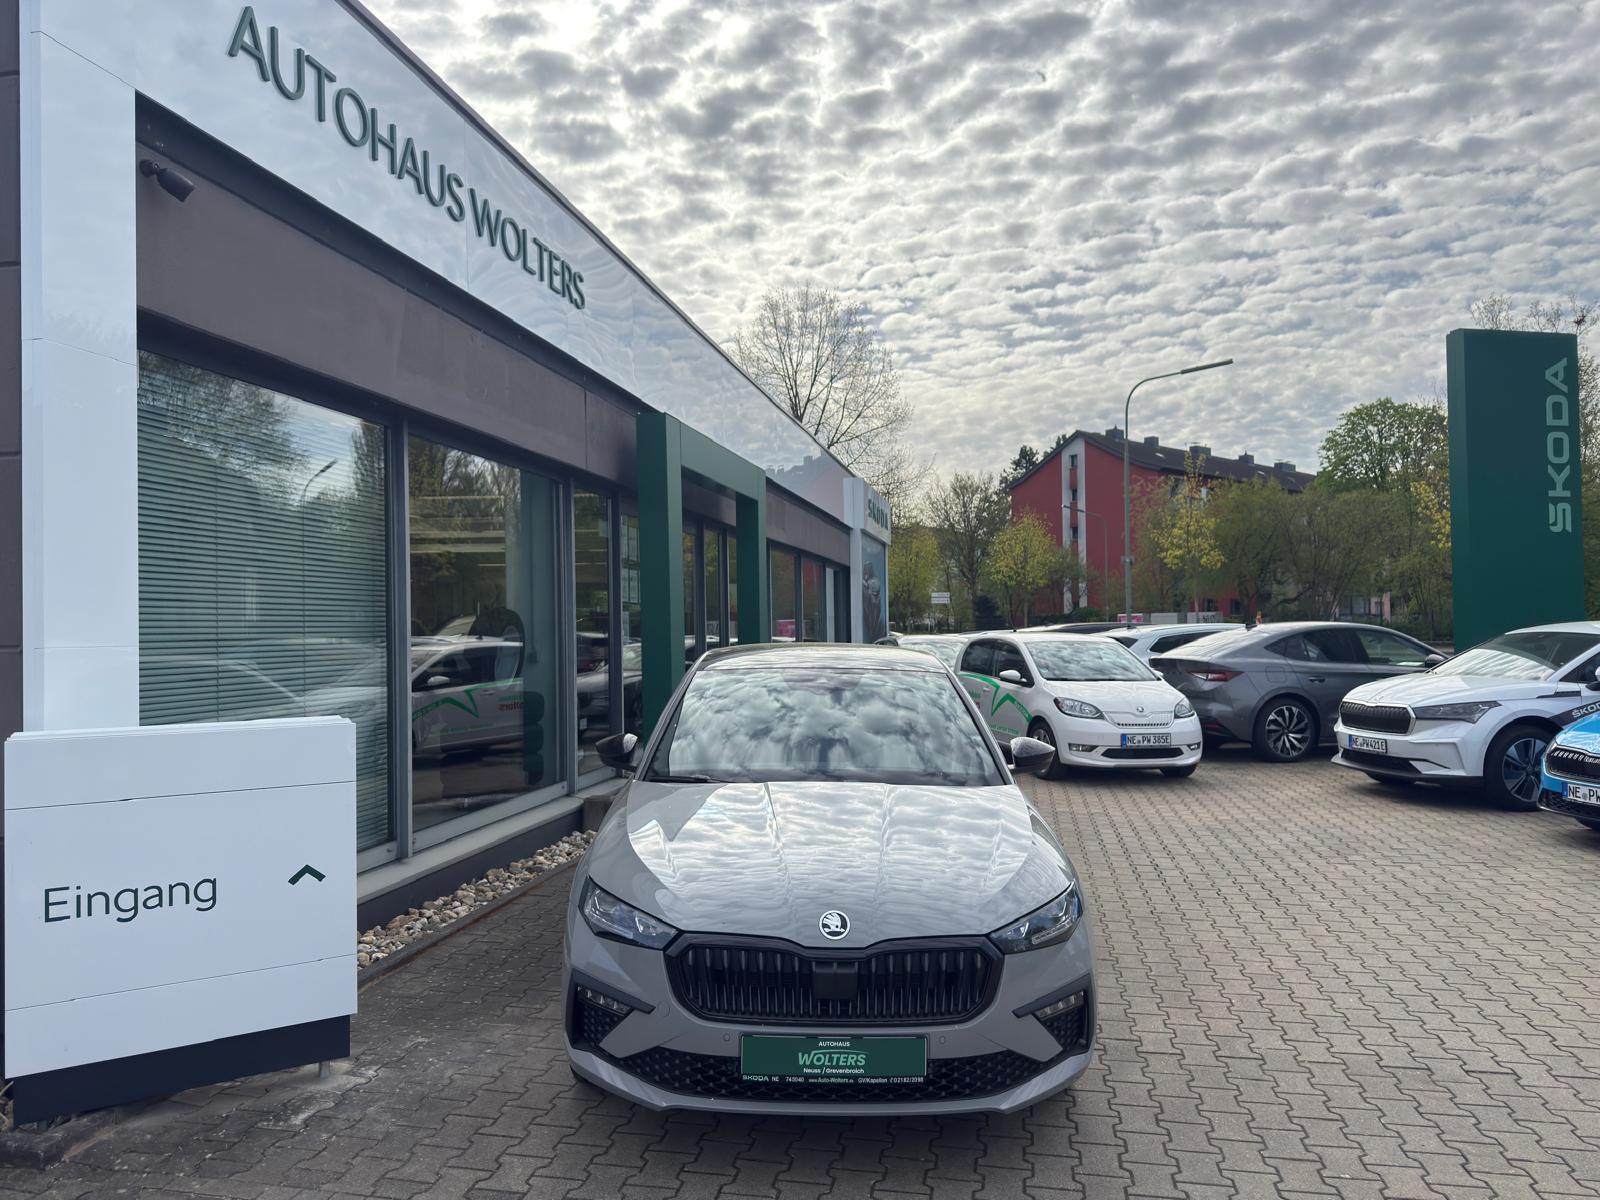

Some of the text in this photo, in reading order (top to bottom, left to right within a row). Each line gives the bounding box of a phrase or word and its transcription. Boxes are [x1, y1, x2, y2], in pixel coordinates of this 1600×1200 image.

[226, 5, 587, 310] AUTOHAUS WOLTERS
[1127, 735, 1137, 745] NE
[1568, 784, 1582, 799] NE
[44, 877, 217, 923] Eingang
[798, 1051, 866, 1066] WOLTERS
